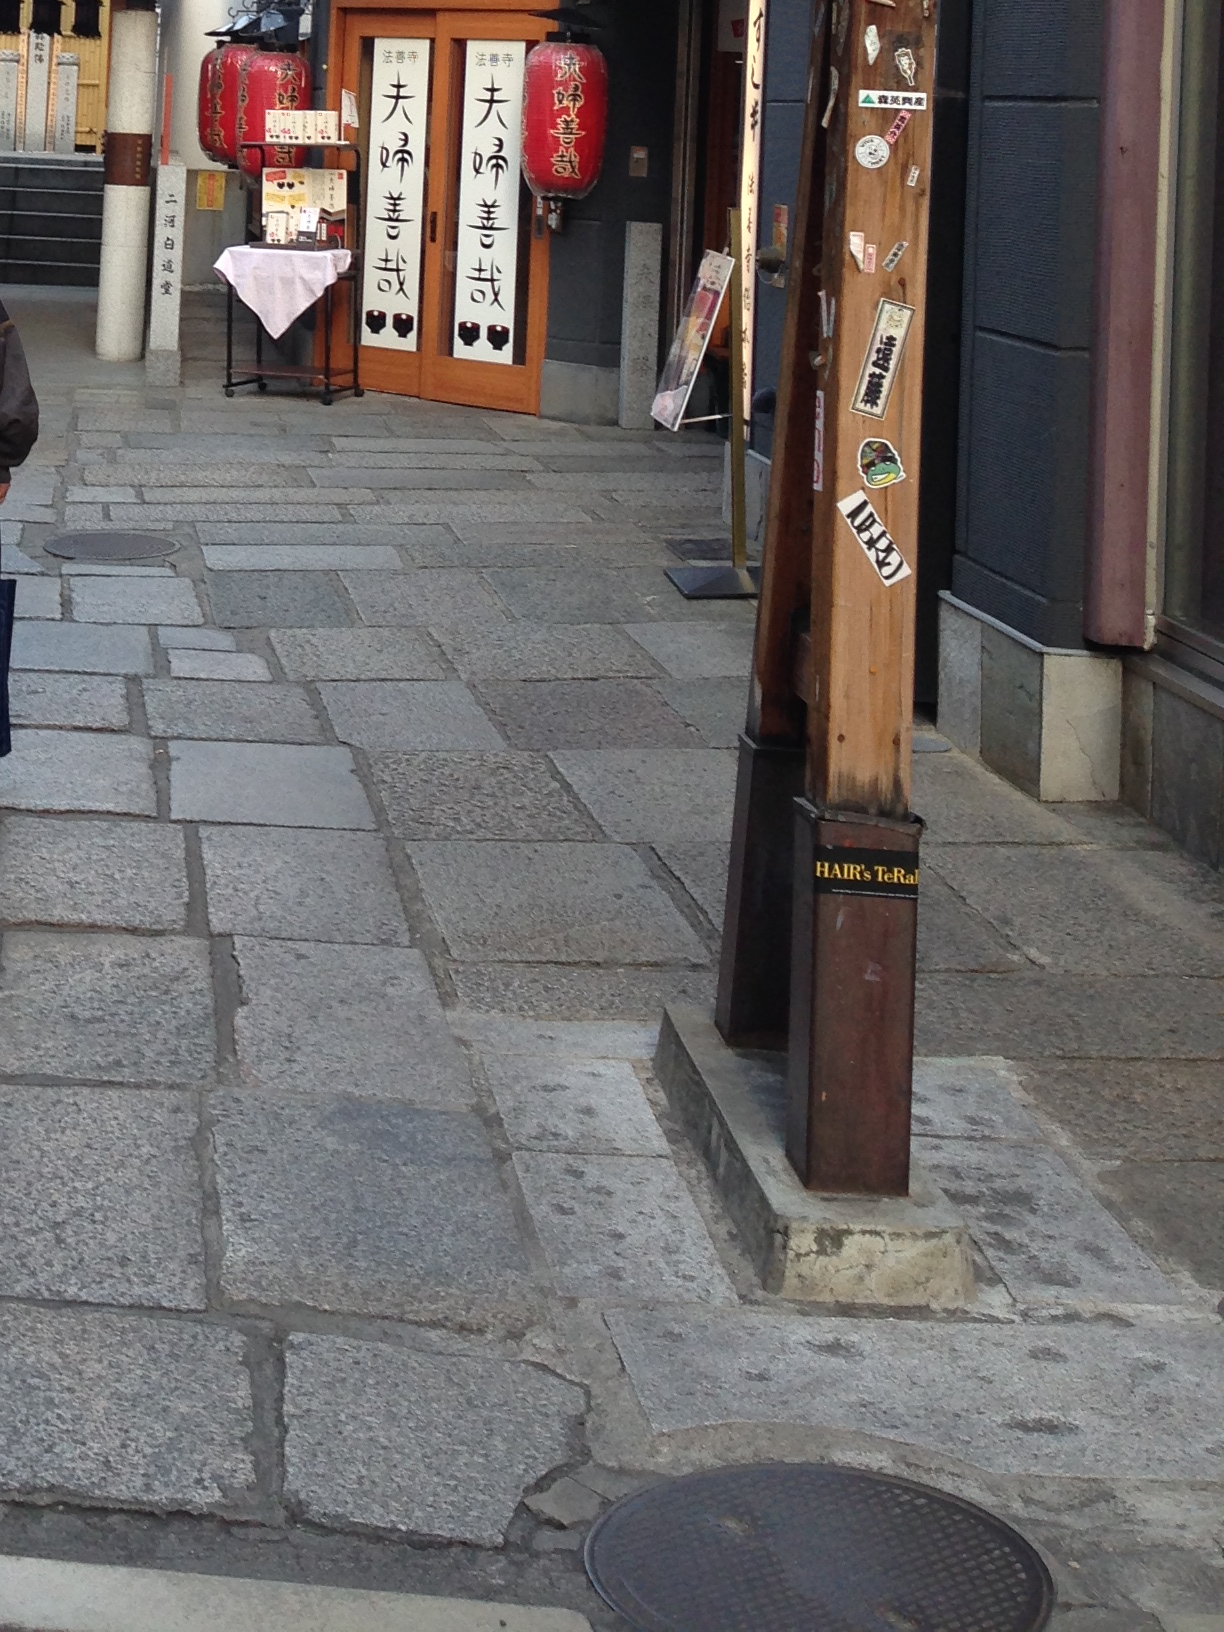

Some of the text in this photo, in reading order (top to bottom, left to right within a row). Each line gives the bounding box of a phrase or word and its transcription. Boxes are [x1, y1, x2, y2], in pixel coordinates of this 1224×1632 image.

[382, 49, 419, 65] 法善寺
[474, 52, 514, 68] 法善寺
[277, 61, 301, 166] 夫婦哉
[551, 51, 587, 179] 夫婦善哉
[372, 70, 417, 302] 夫婦善哉
[465, 73, 513, 313] 夫婦善哉
[815, 861, 872, 882] HAIR's
